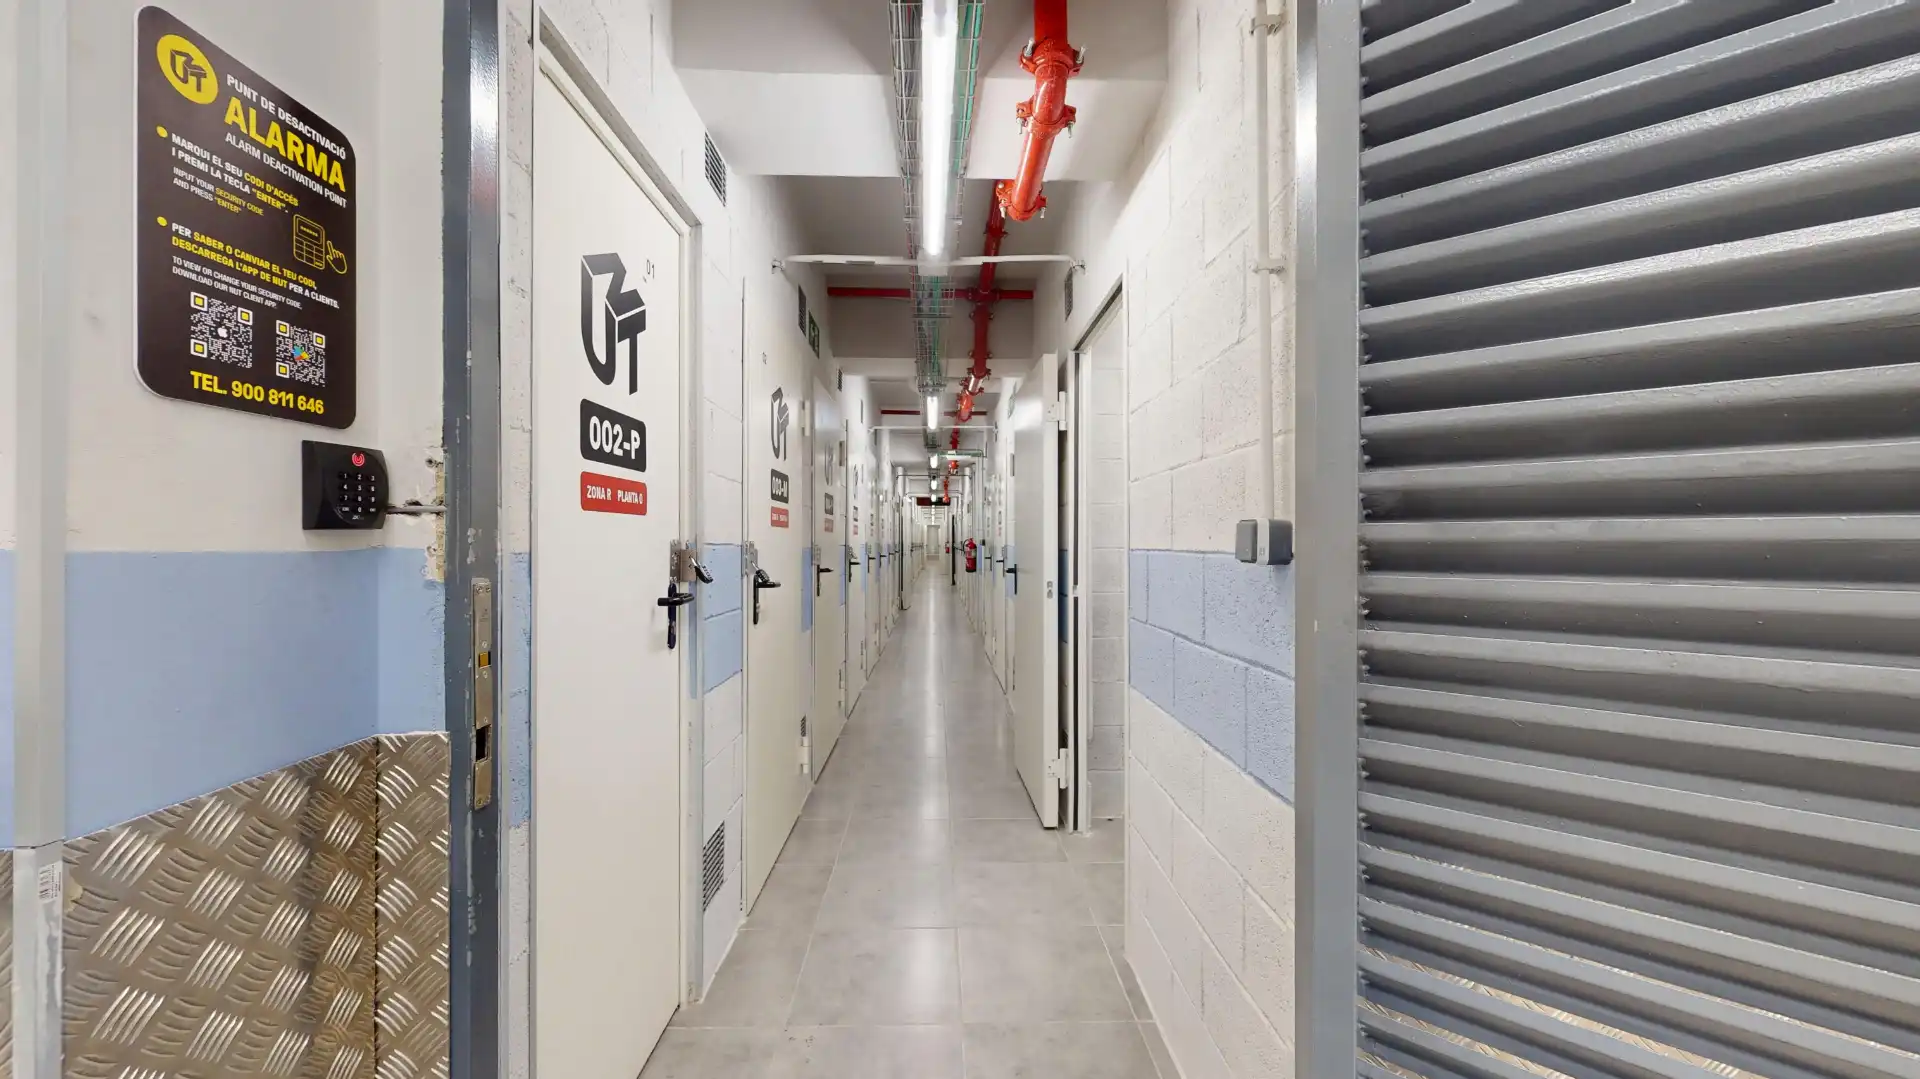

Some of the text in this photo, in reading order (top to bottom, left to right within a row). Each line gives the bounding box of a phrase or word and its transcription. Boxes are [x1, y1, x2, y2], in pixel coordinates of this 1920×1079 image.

[227, 73, 346, 160] PUNT DE DESACTIVACIÓ
[172, 133, 210, 160] MARQUI
[212, 152, 223, 168] EL
[225, 161, 243, 177] SEU
[244, 172, 264, 189] CODI
[224, 96, 346, 192] ALARMA
[172, 147, 176, 156] I
[178, 150, 208, 172] PREMI
[210, 166, 222, 180] LA
[224, 173, 250, 194] TECLA
[173, 166, 195, 183] INPUT
[195, 177, 215, 192] YOUR
[215, 187, 246, 207] SECURITY
[173, 177, 189, 190] AND
[190, 185, 213, 201] PRESS
[225, 132, 347, 209] ALARM DEACTIVATION POINT
[172, 222, 191, 238] PER
[193, 231, 224, 251] SABER
[226, 245, 233, 255] O
[234, 249, 270, 270] CANVIAR
[272, 263, 281, 275] EL
[282, 268, 297, 280] TEU
[172, 236, 234, 268] DESCARREGA
[235, 261, 259, 276] L'APP
[260, 270, 271, 282] DE
[272, 276, 288, 289] NUT
[289, 282, 304, 295] PER
[304, 289, 310, 298] A
[172, 255, 182, 266] TO
[183, 259, 202, 272] VIEW
[202, 266, 213, 277] OR
[213, 271, 240, 287] CHANGE
[241, 280, 257, 293] YOUR
[258, 287, 286, 303] SECURITY
[172, 266, 213, 286] DOWNLOAD
[214, 281, 228, 292] OUR
[229, 284, 243, 297] NUT
[243, 291, 264, 304] CLIENT
[190, 371, 324, 415] TEL. 900 811 646
[589, 415, 640, 460] 002-P
[586, 485, 605, 501] ZONA
[606, 488, 612, 501] R
[617, 489, 638, 504] PLANTA
